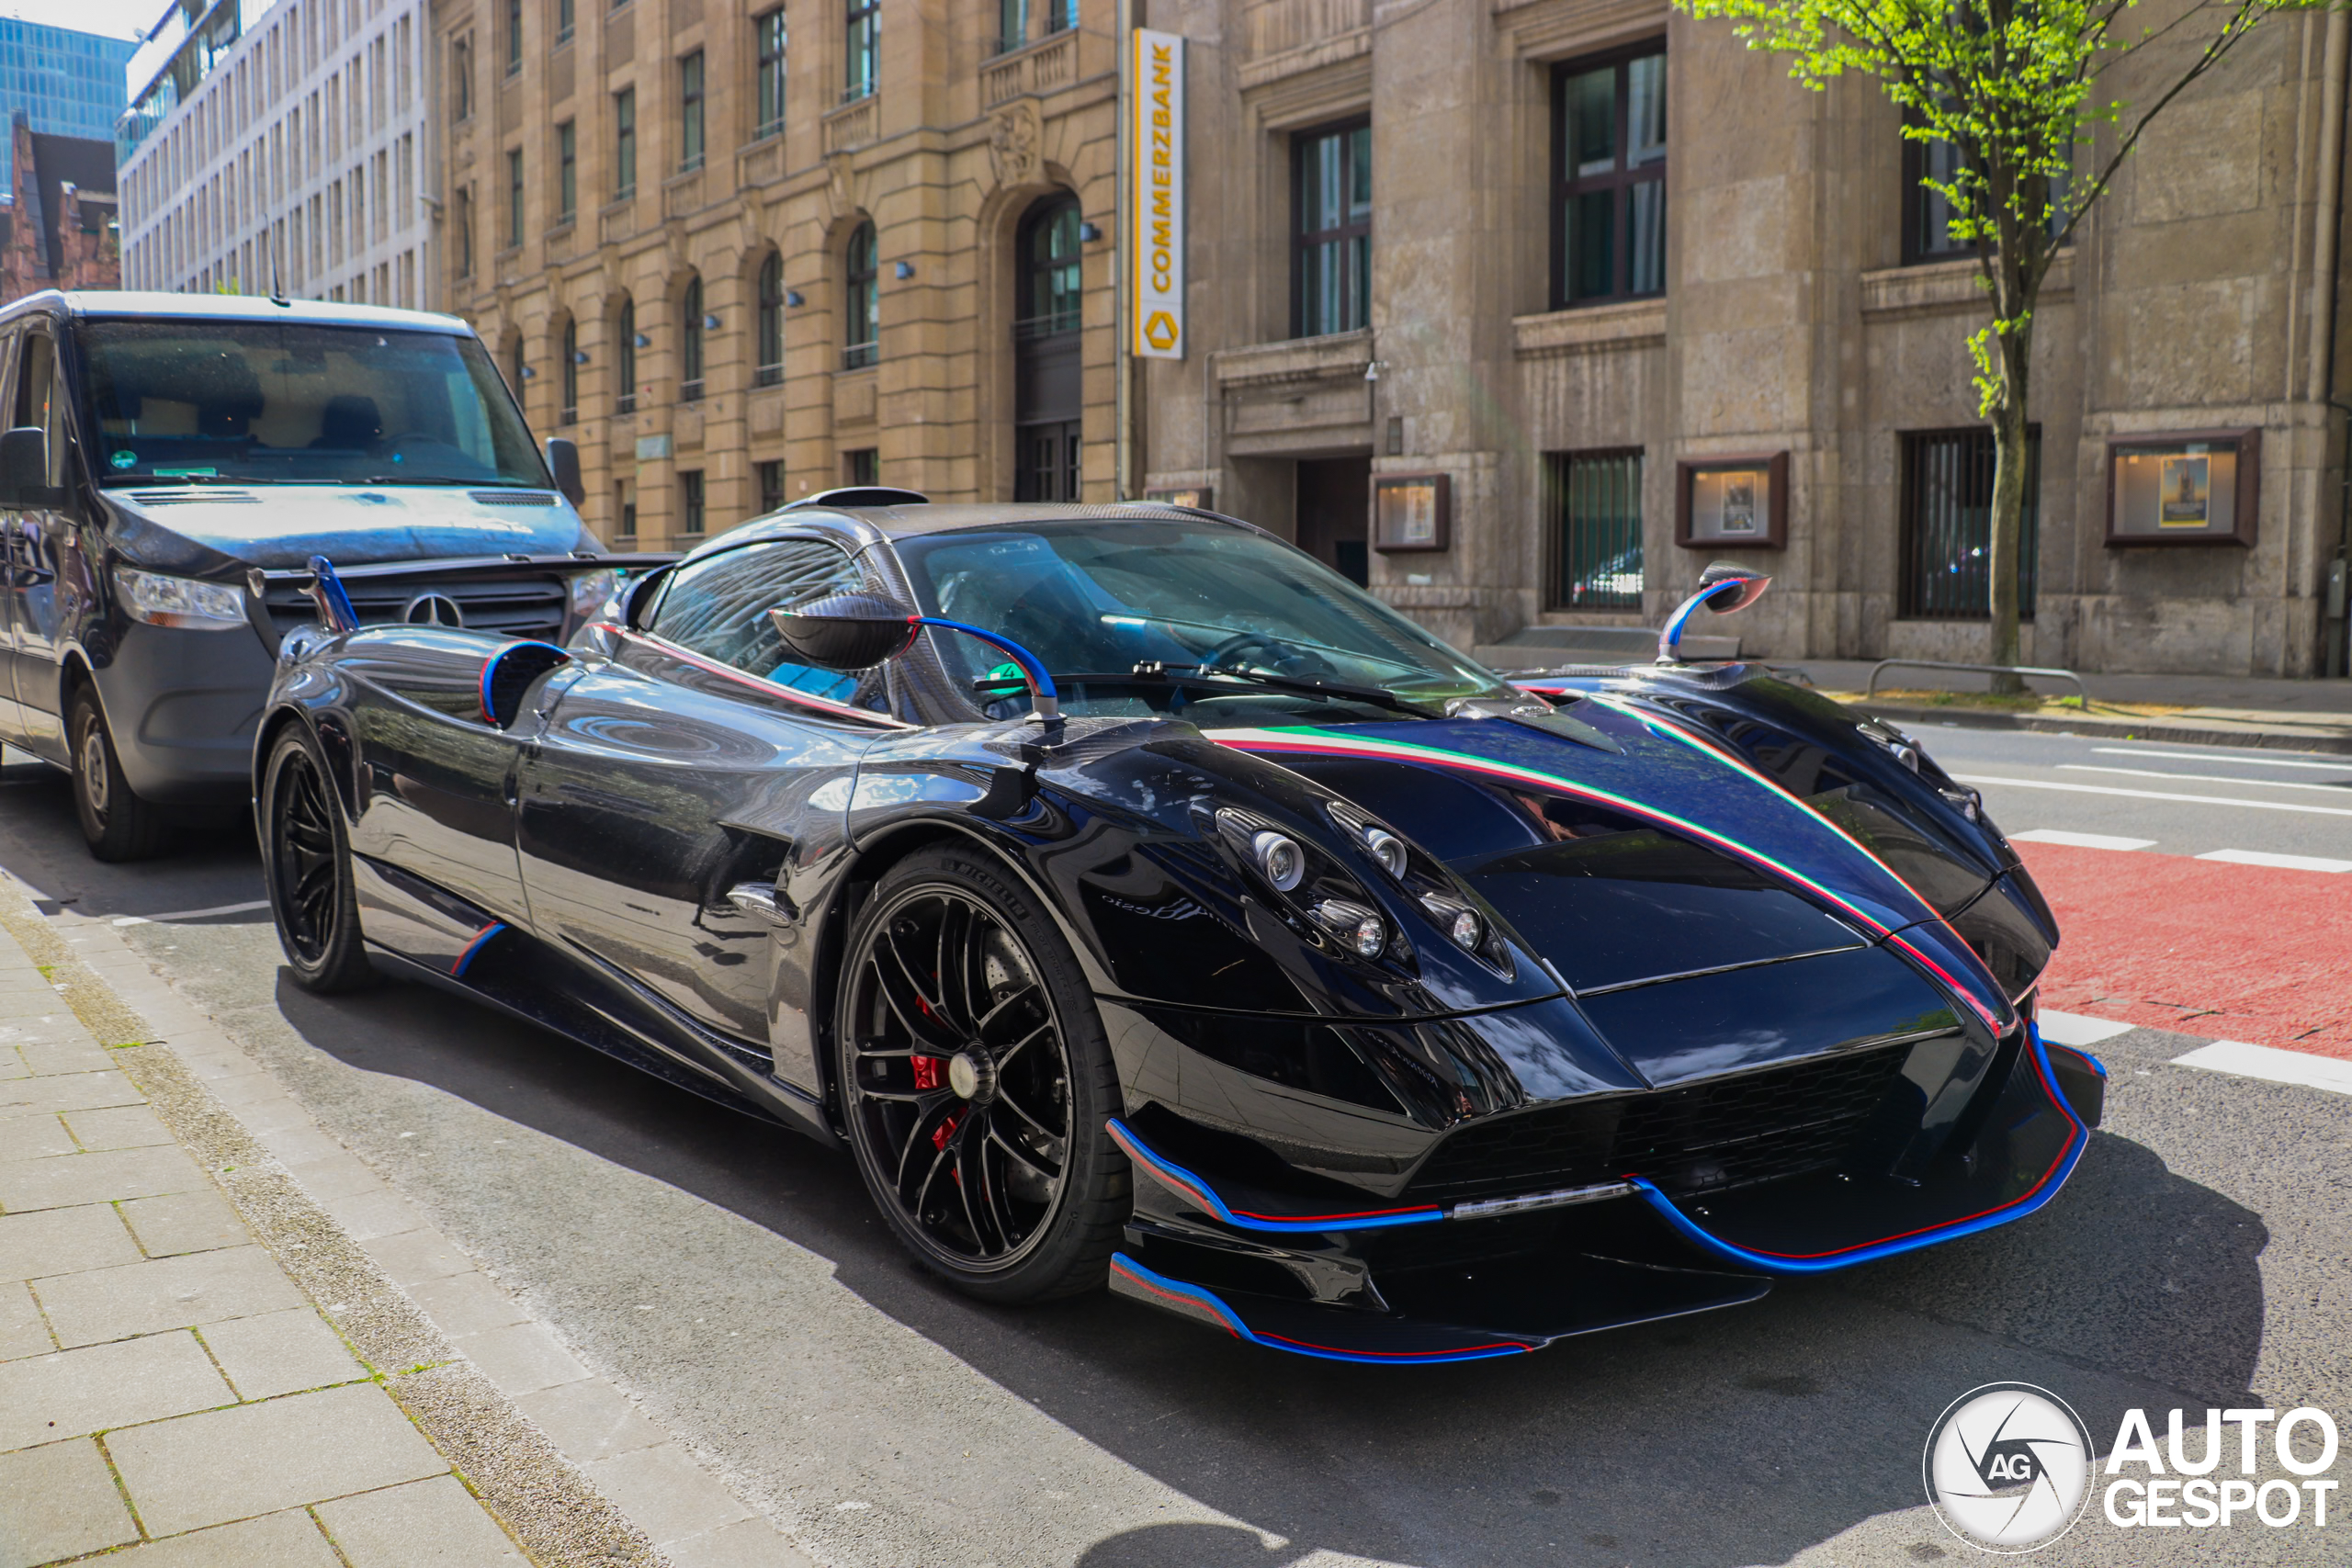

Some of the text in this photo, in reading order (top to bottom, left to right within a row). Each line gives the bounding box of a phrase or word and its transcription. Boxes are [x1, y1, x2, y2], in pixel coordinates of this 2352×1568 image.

[1151, 42, 1172, 294] COMMERZBANK
[1001, 665, 1014, 678] 4
[956, 863, 1026, 916] MICHELIN
[1031, 923, 1049, 947] PILOT
